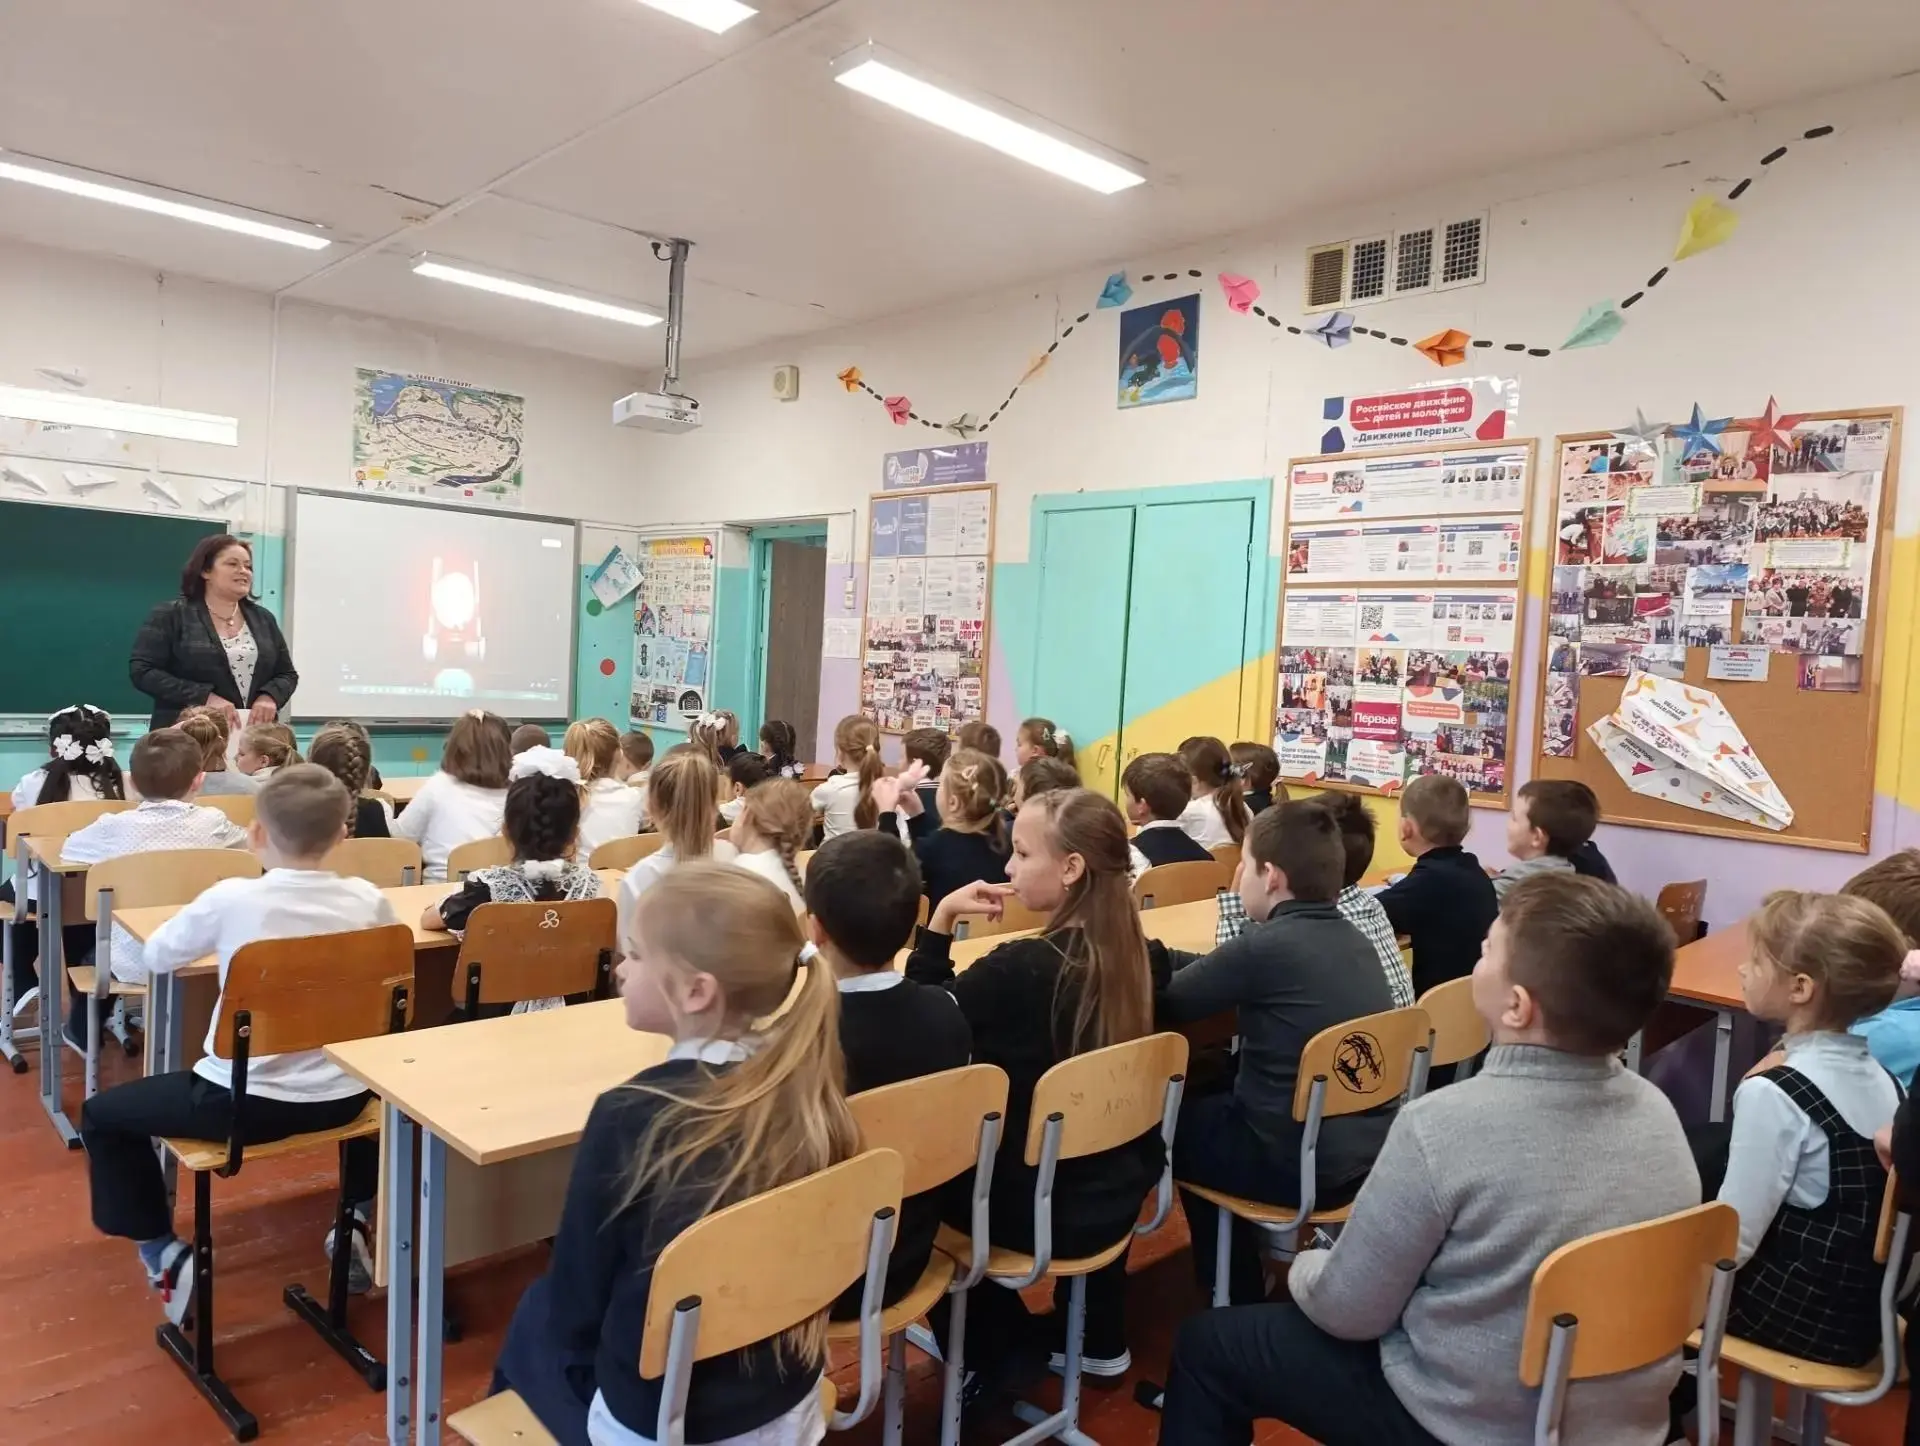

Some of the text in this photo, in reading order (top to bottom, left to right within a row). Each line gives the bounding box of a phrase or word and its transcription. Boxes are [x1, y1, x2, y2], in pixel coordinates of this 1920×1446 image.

[1356, 395, 1466, 414] Российское движение
[1372, 410, 1402, 423] детей
[1403, 411, 1410, 419] и
[1353, 430, 1412, 443] «Движение
[1415, 426, 1465, 438] Первых»
[960, 620, 972, 630] МЫ
[1354, 712, 1398, 727] Первые
